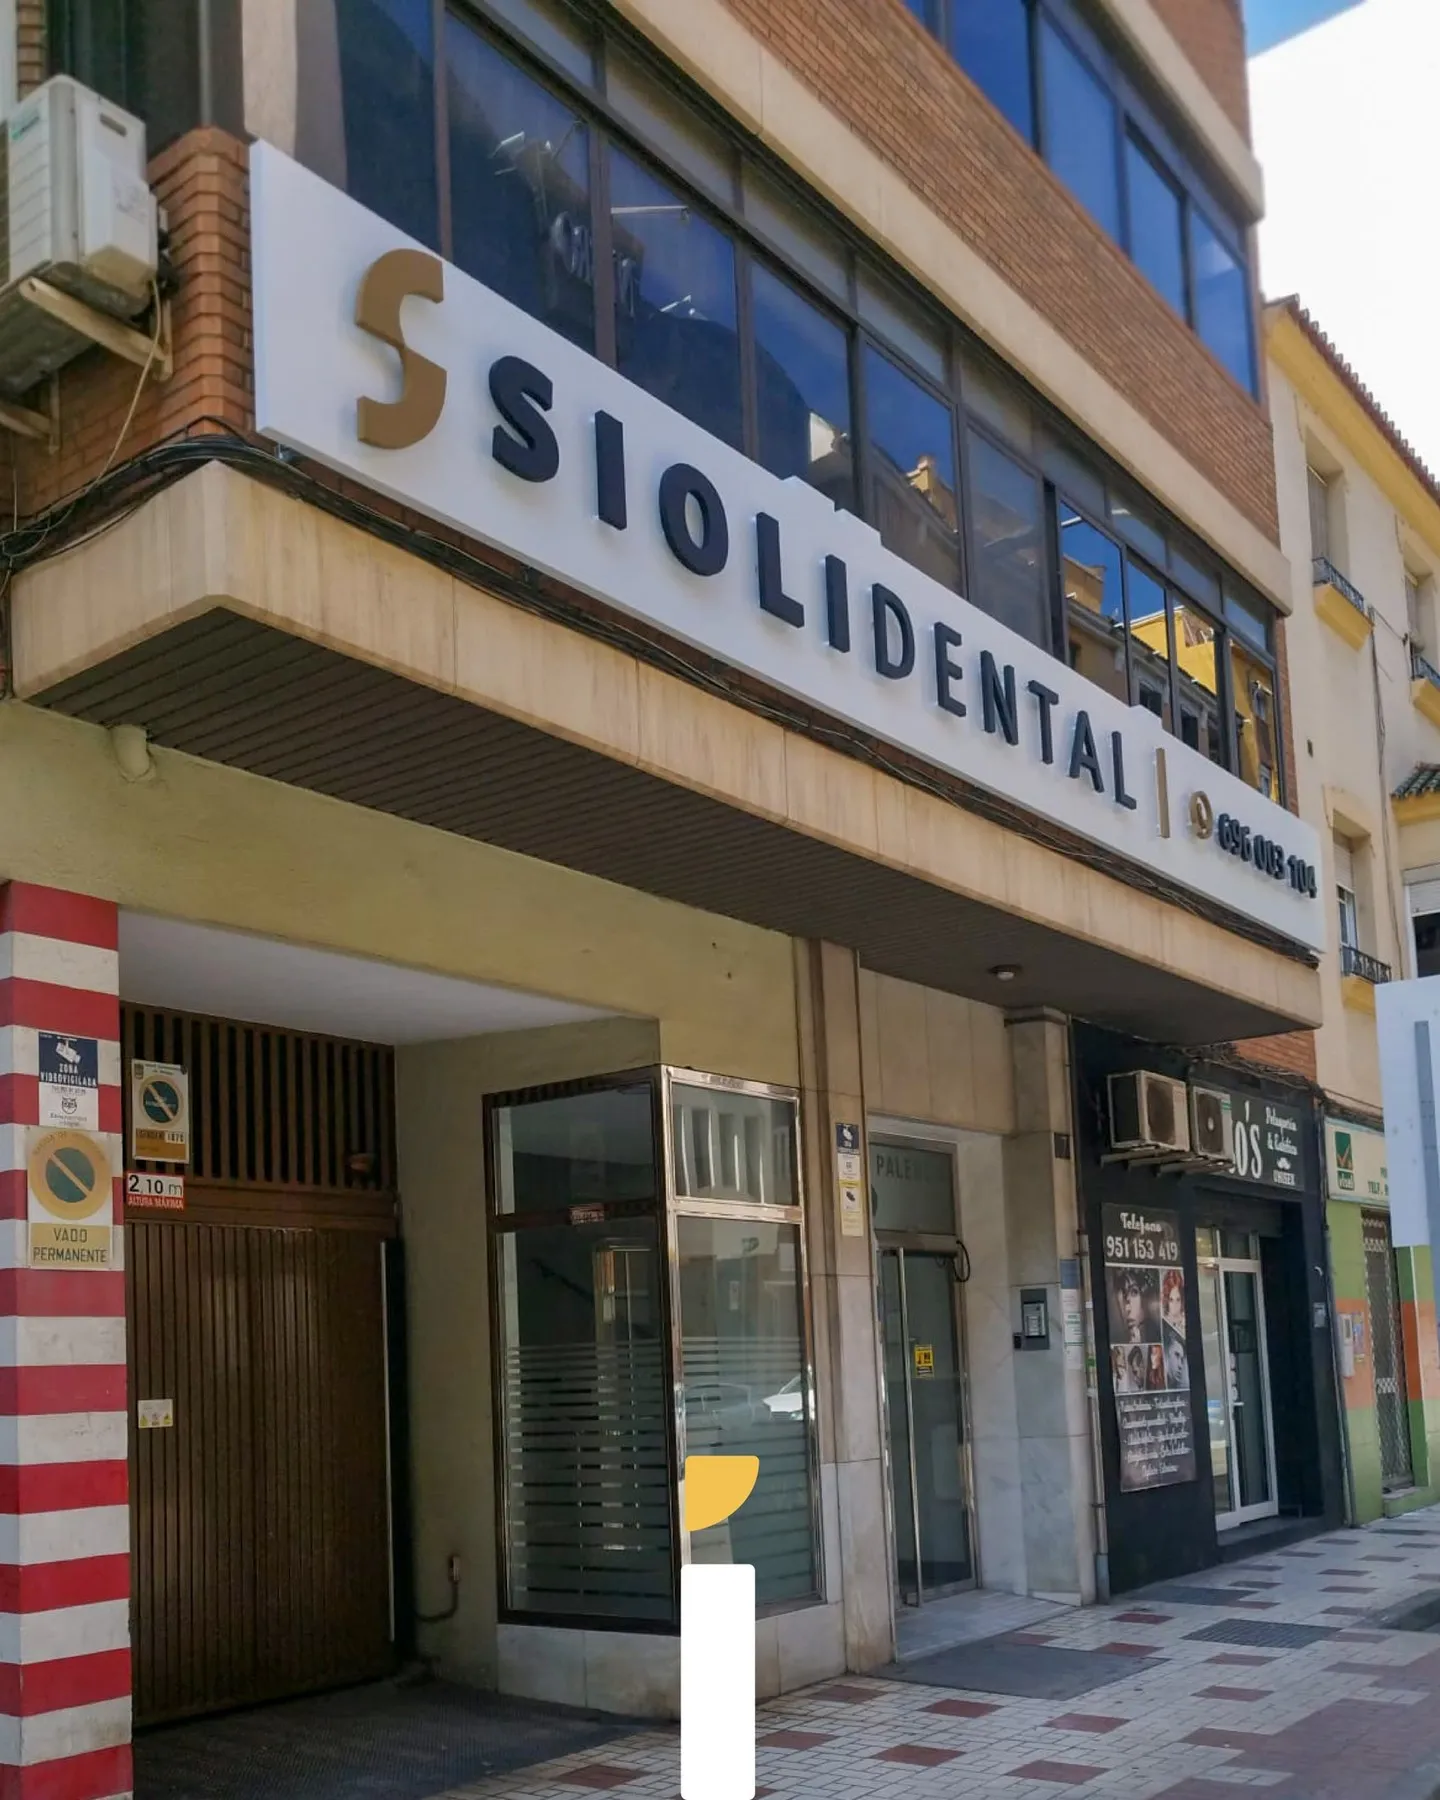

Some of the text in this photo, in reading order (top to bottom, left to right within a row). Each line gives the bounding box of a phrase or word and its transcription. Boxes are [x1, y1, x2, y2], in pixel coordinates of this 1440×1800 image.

[1217, 812, 1318, 899] 696 003 104
[1229, 1100, 1263, 1180] O'S
[168, 1183, 183, 1196] m
[53, 1227, 88, 1243] VADO
[32, 1246, 108, 1263] PERMANENTE
[1106, 1235, 1178, 1261] 951 153 419
